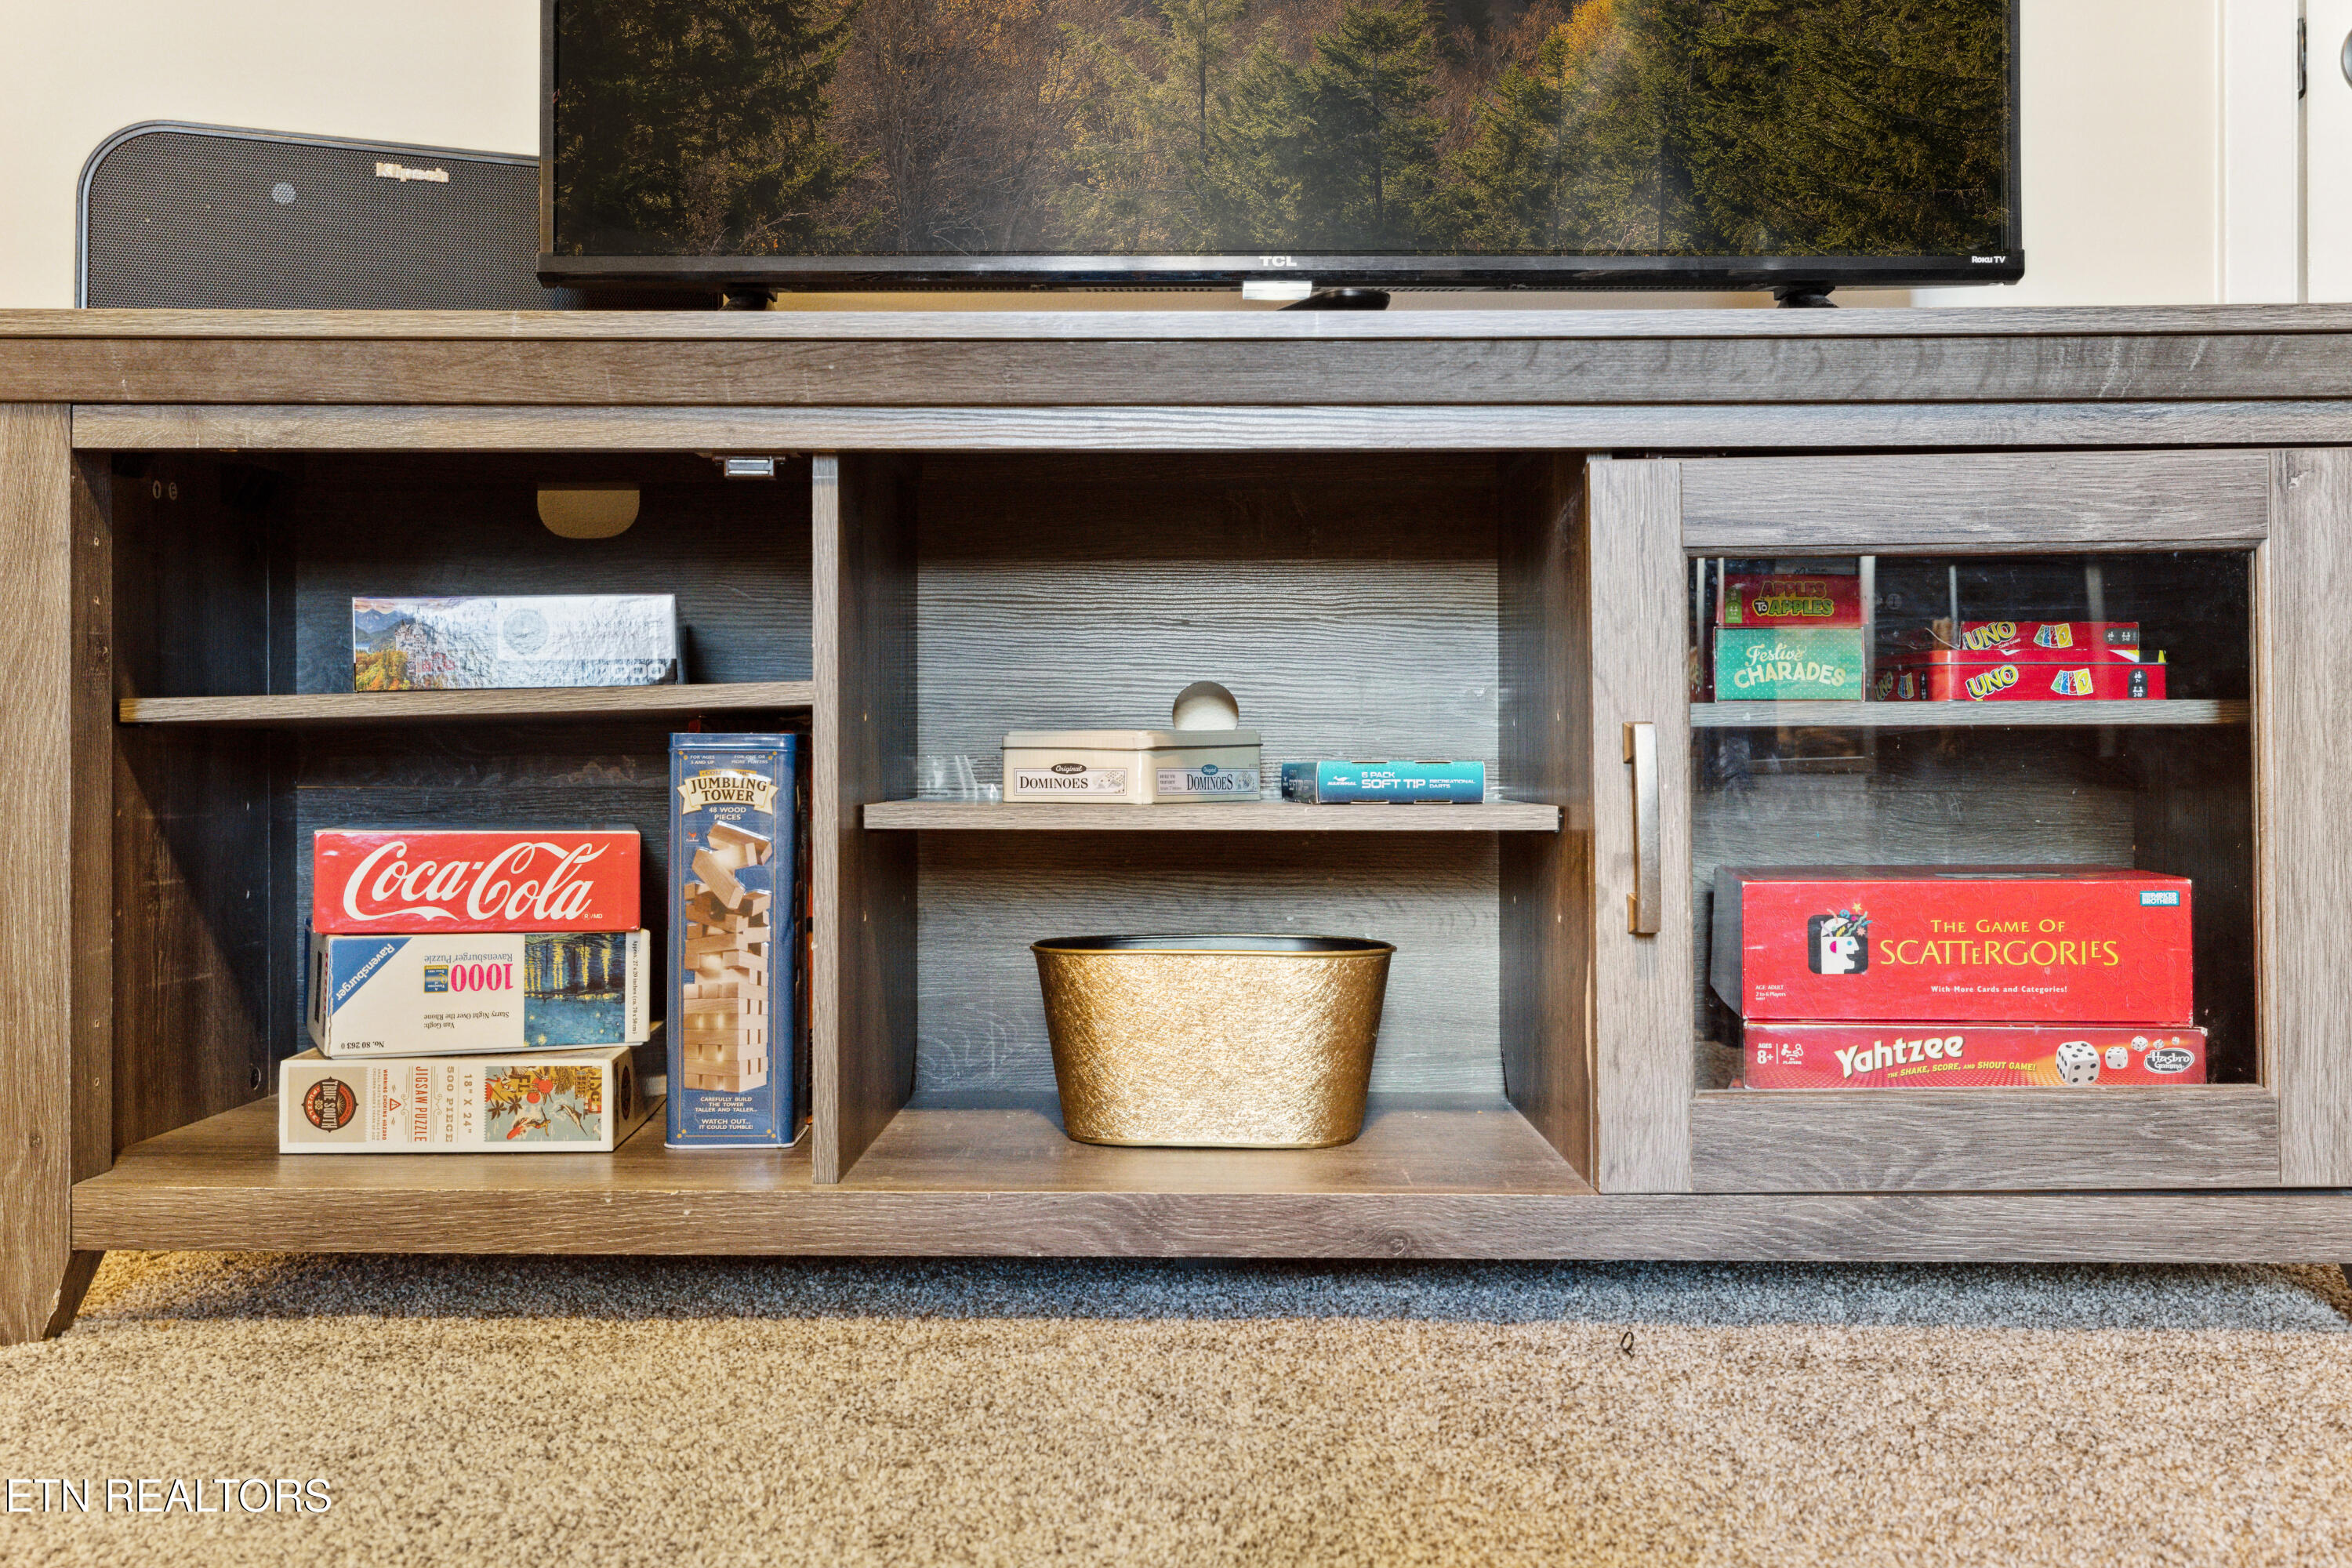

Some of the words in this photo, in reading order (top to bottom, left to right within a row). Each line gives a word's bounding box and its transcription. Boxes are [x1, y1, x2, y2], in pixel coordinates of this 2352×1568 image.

[1259, 256, 1297, 267] TCL
[1761, 581, 1826, 598] APPLES
[1769, 599, 1833, 615] APPLES
[1962, 622, 2016, 650] UNO
[1745, 642, 1806, 666] Festive
[1734, 662, 1846, 688] CHARADES
[1965, 665, 2019, 699] UNO
[691, 777, 767, 794] JUMBLING
[1019, 776, 1088, 789] DOMINOES
[1186, 774, 1233, 790] DOMINOES
[1361, 779, 1401, 789] SOFT
[1403, 779, 1426, 789] TIP
[702, 789, 754, 802] TOWER
[343, 840, 611, 922] Coca-Cola
[1930, 919, 1967, 933] THE
[1976, 919, 2031, 933] GAME
[424, 954, 452, 964] Puzzle
[1880, 940, 2119, 966] SCATTERGORIES
[336, 943, 395, 1001] Ravensburger
[451, 964, 514, 993] 1000
[2021, 985, 2067, 994] Categories!
[473, 1011, 489, 1019] Night
[1757, 1050, 1774, 1065] 8+
[1834, 1036, 1964, 1079] Yahtzee
[2147, 1051, 2190, 1065] Hasbro
[1900, 1065, 1930, 1076] SHAKE,
[1932, 1062, 1961, 1073] SCORE,
[1977, 1061, 2007, 1069] SHOUT
[2009, 1061, 2036, 1072] GAME!
[322, 1080, 339, 1101] TRUE
[415, 1066, 428, 1104] JIGSAW
[463, 1074, 472, 1094] 18"
[307, 1091, 318, 1120] PUZZLE
[321, 1102, 338, 1128] SOUTH
[414, 1107, 427, 1142] PUZZLE
[445, 1098, 454, 1142] PIECE
[463, 1112, 472, 1134] 24"
